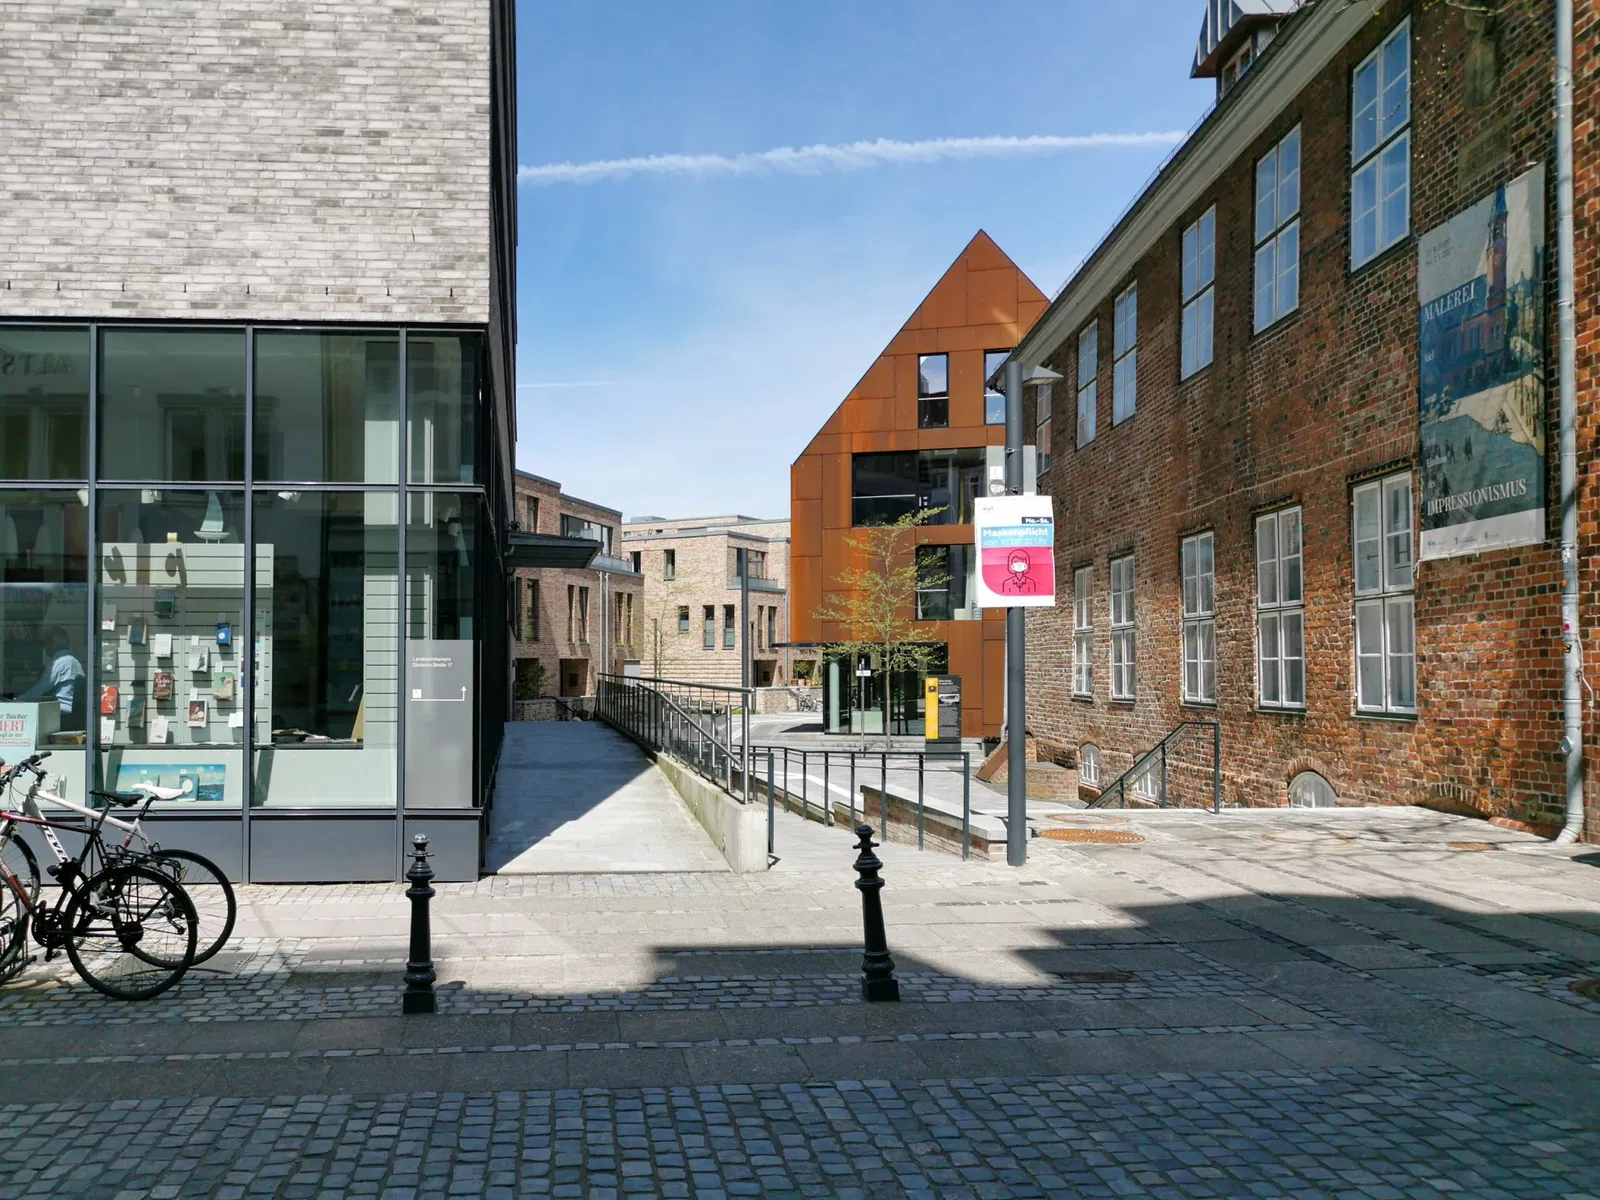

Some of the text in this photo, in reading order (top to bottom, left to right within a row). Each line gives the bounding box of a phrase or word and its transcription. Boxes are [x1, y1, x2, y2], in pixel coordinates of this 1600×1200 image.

[1424, 281, 1476, 322] MALEREI
[1426, 478, 1527, 516] IMPRESSIONISMUS
[983, 528, 1048, 537] Maskenpflicht
